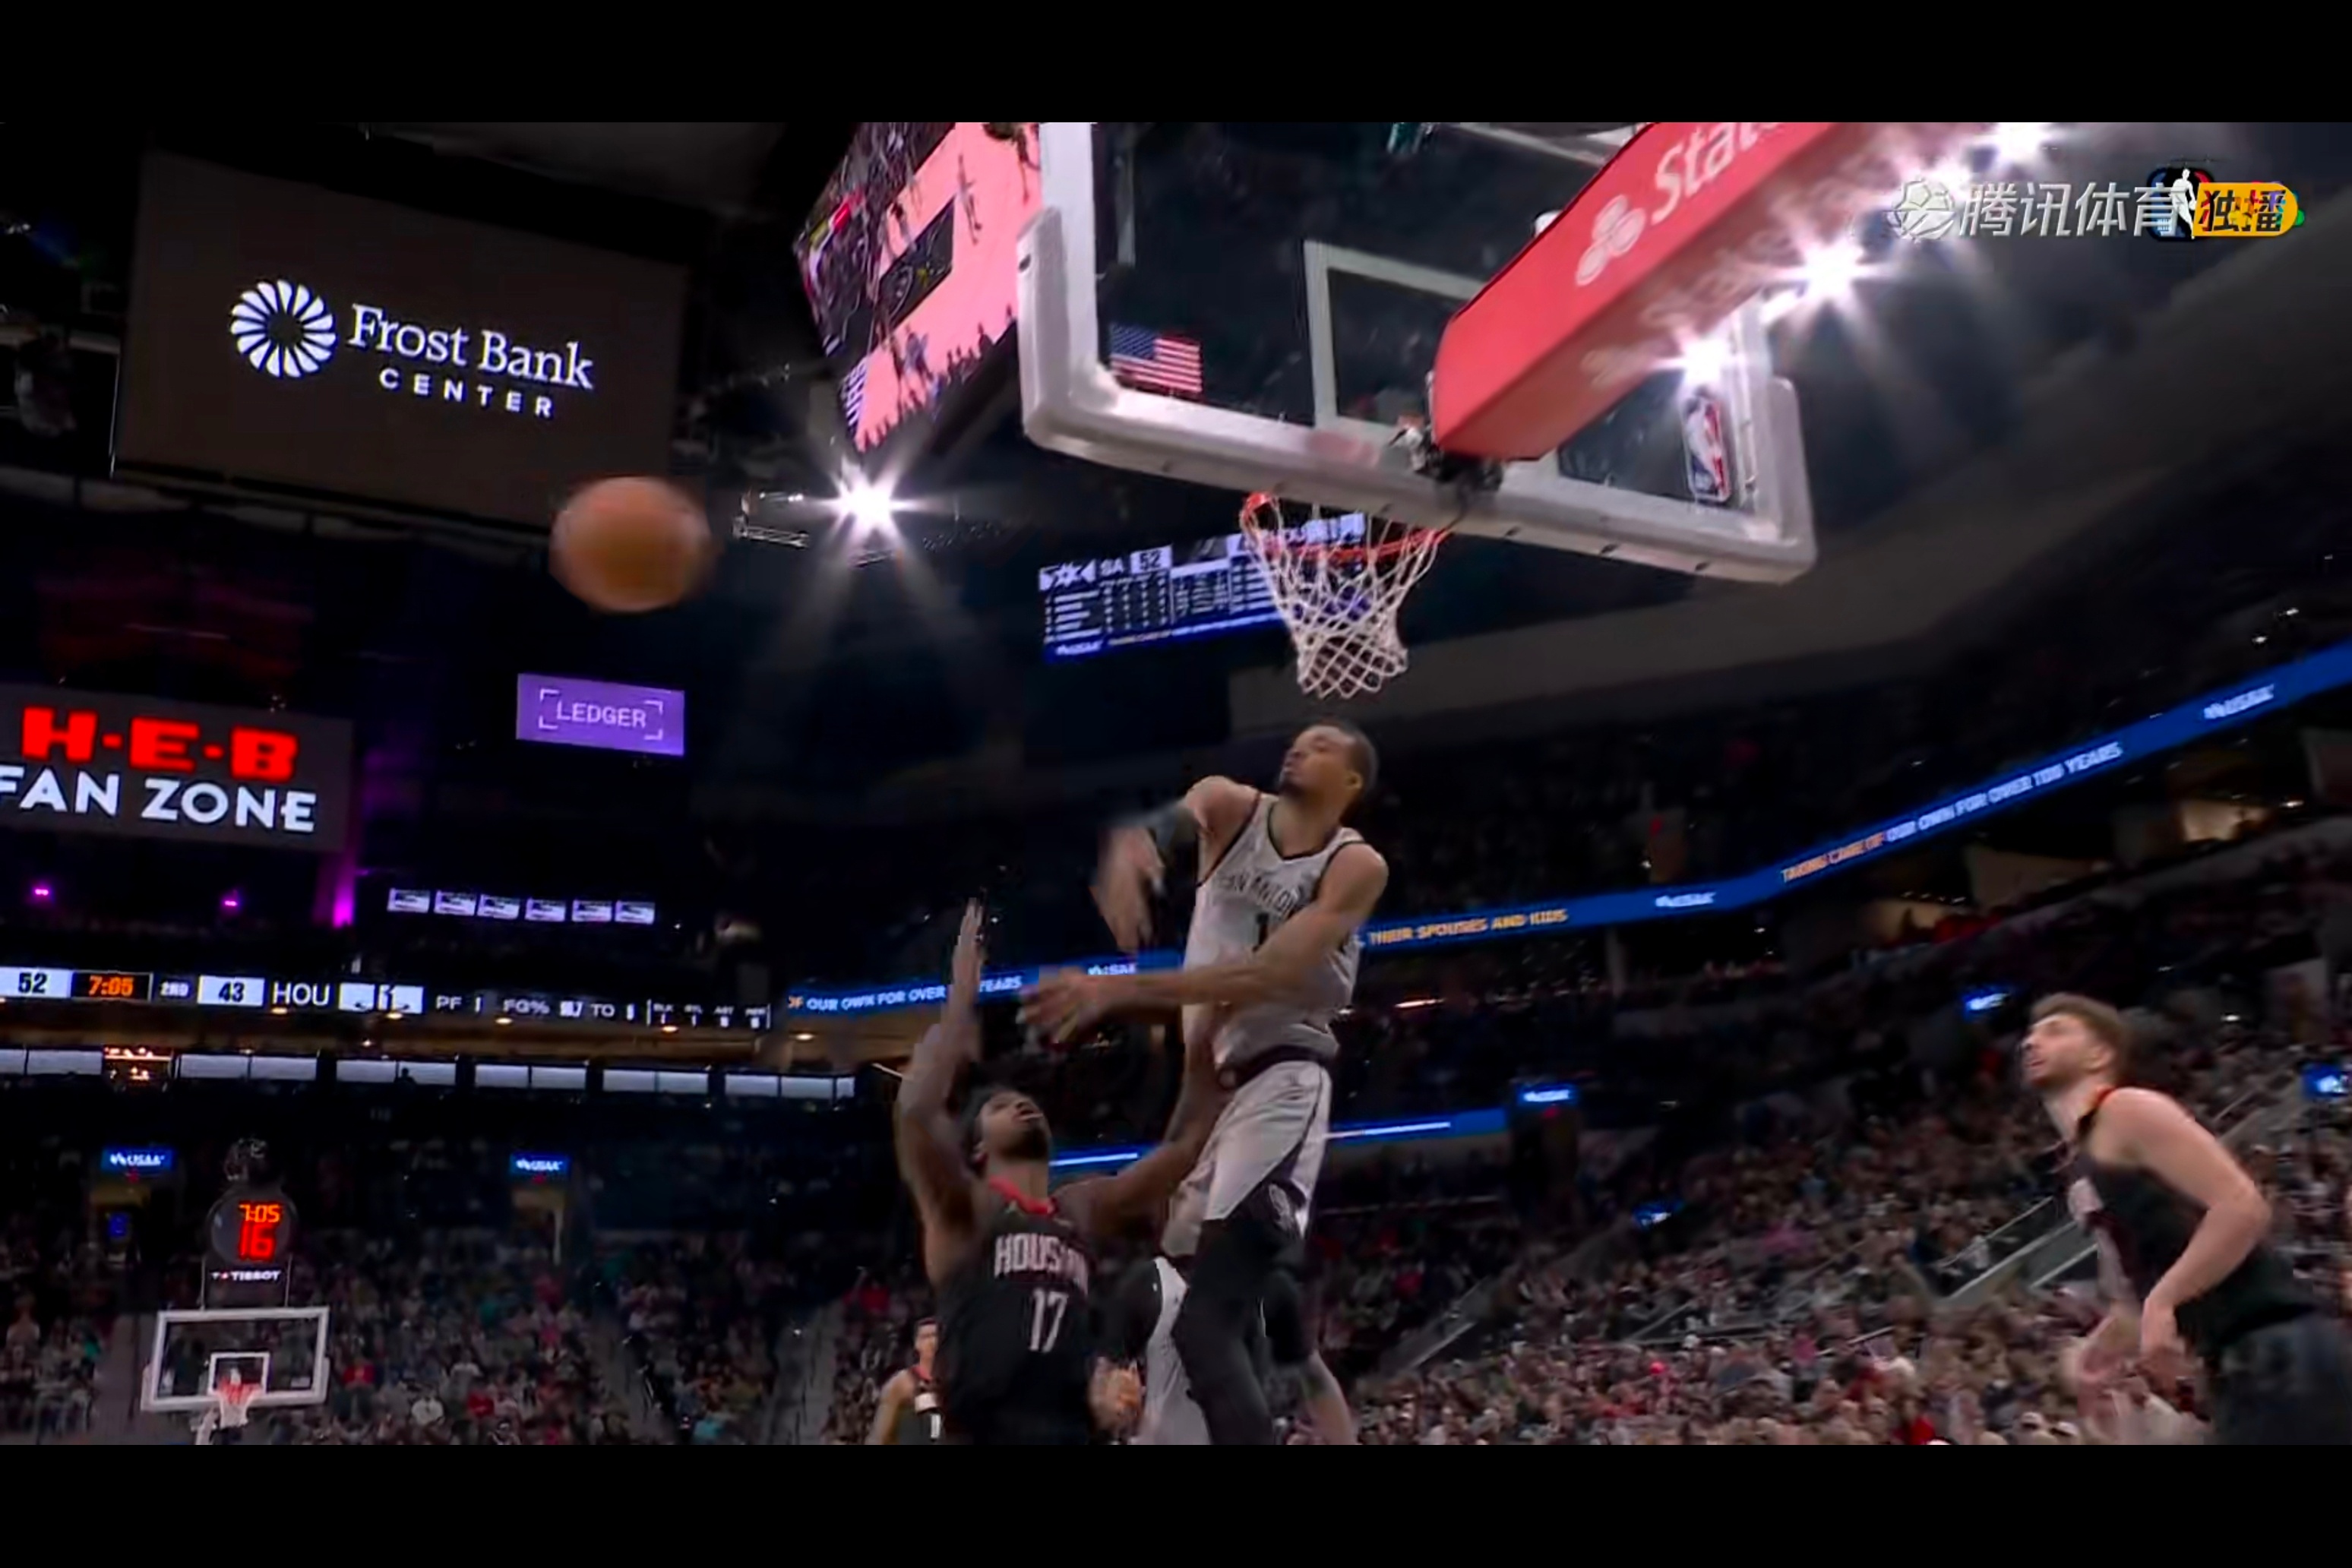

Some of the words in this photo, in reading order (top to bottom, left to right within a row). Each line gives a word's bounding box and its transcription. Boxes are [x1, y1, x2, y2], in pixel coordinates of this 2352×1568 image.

[348, 303, 468, 367] Frost
[477, 330, 595, 390] Bank
[379, 368, 552, 418] CENTER
[556, 700, 646, 729] LEDGER
[0, 764, 120, 817] FAN
[141, 777, 318, 833] ZONE
[18, 972, 48, 994] 52
[88, 975, 134, 996] 7:05
[218, 982, 245, 1003] 43
[273, 982, 330, 1007] HOU
[436, 994, 463, 1010] PF
[590, 1003, 615, 1017] TO
[806, 997, 838, 1011] OUR
[841, 994, 875, 1010] OWN
[877, 991, 906, 1005] FOR
[909, 985, 947, 1002] OVER
[239, 1204, 281, 1223] 7:05
[239, 1222, 274, 1258] 16
[1029, 1287, 1069, 1354] 17
